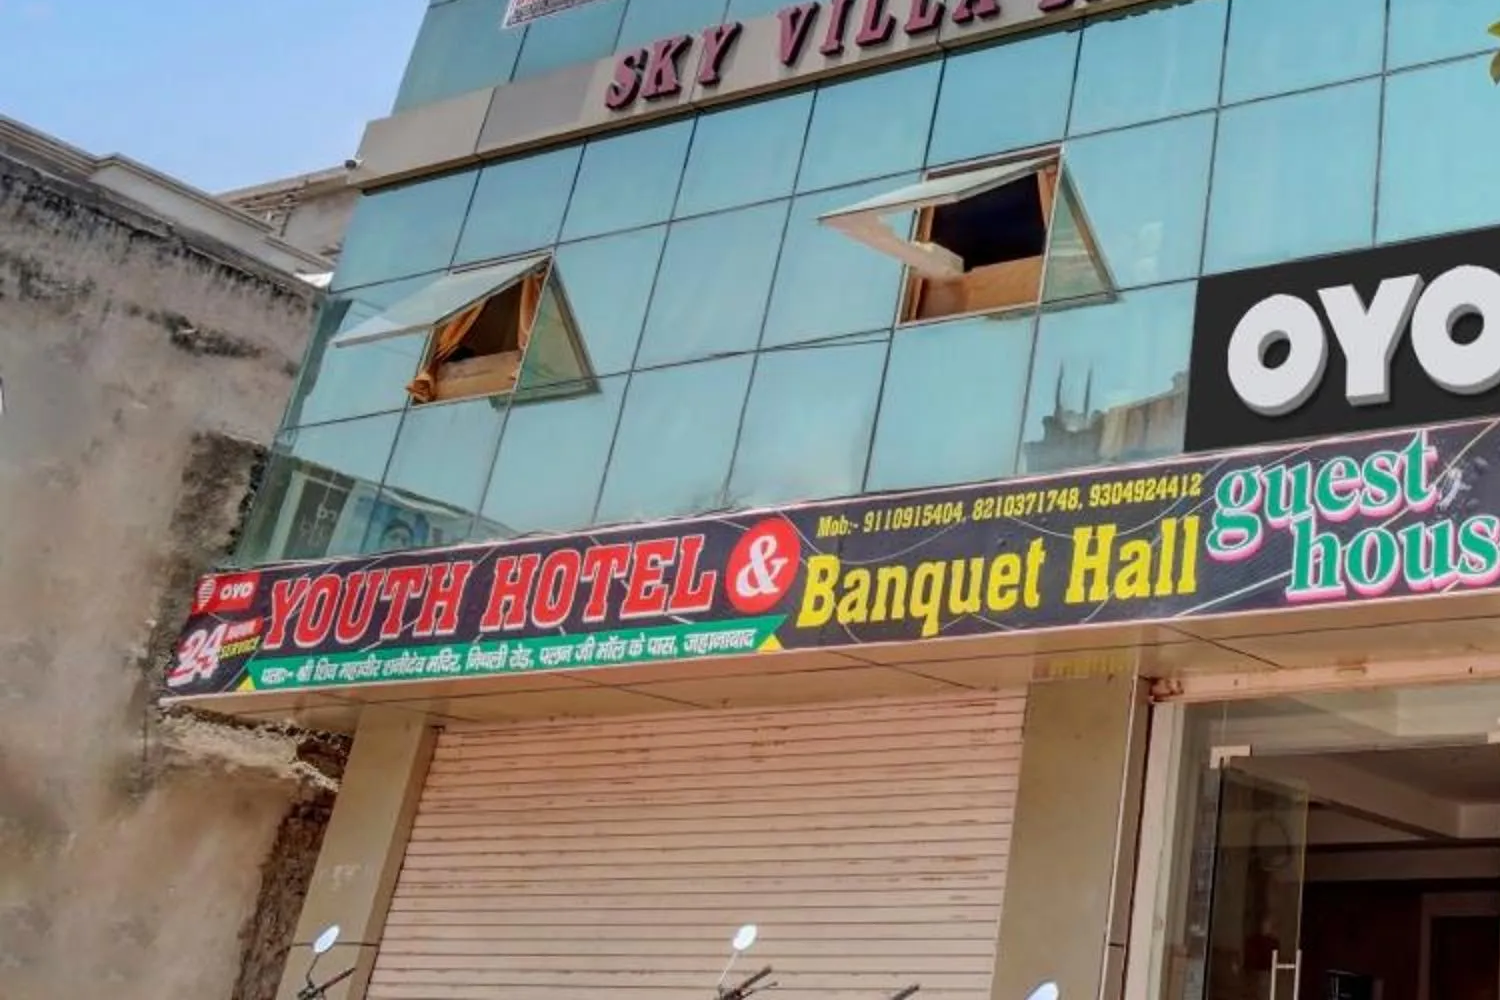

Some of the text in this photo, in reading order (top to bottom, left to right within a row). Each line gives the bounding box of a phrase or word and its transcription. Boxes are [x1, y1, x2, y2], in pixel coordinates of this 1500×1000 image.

[605, 21, 743, 111] SKY
[1088, 472, 1203, 508] 9304924412
[1205, 429, 1440, 561] guest
[220, 581, 256, 600] OYO
[263, 515, 1200, 650] YOUTH HOTEL & Banquet Hall
[627, 632, 645, 656] के
